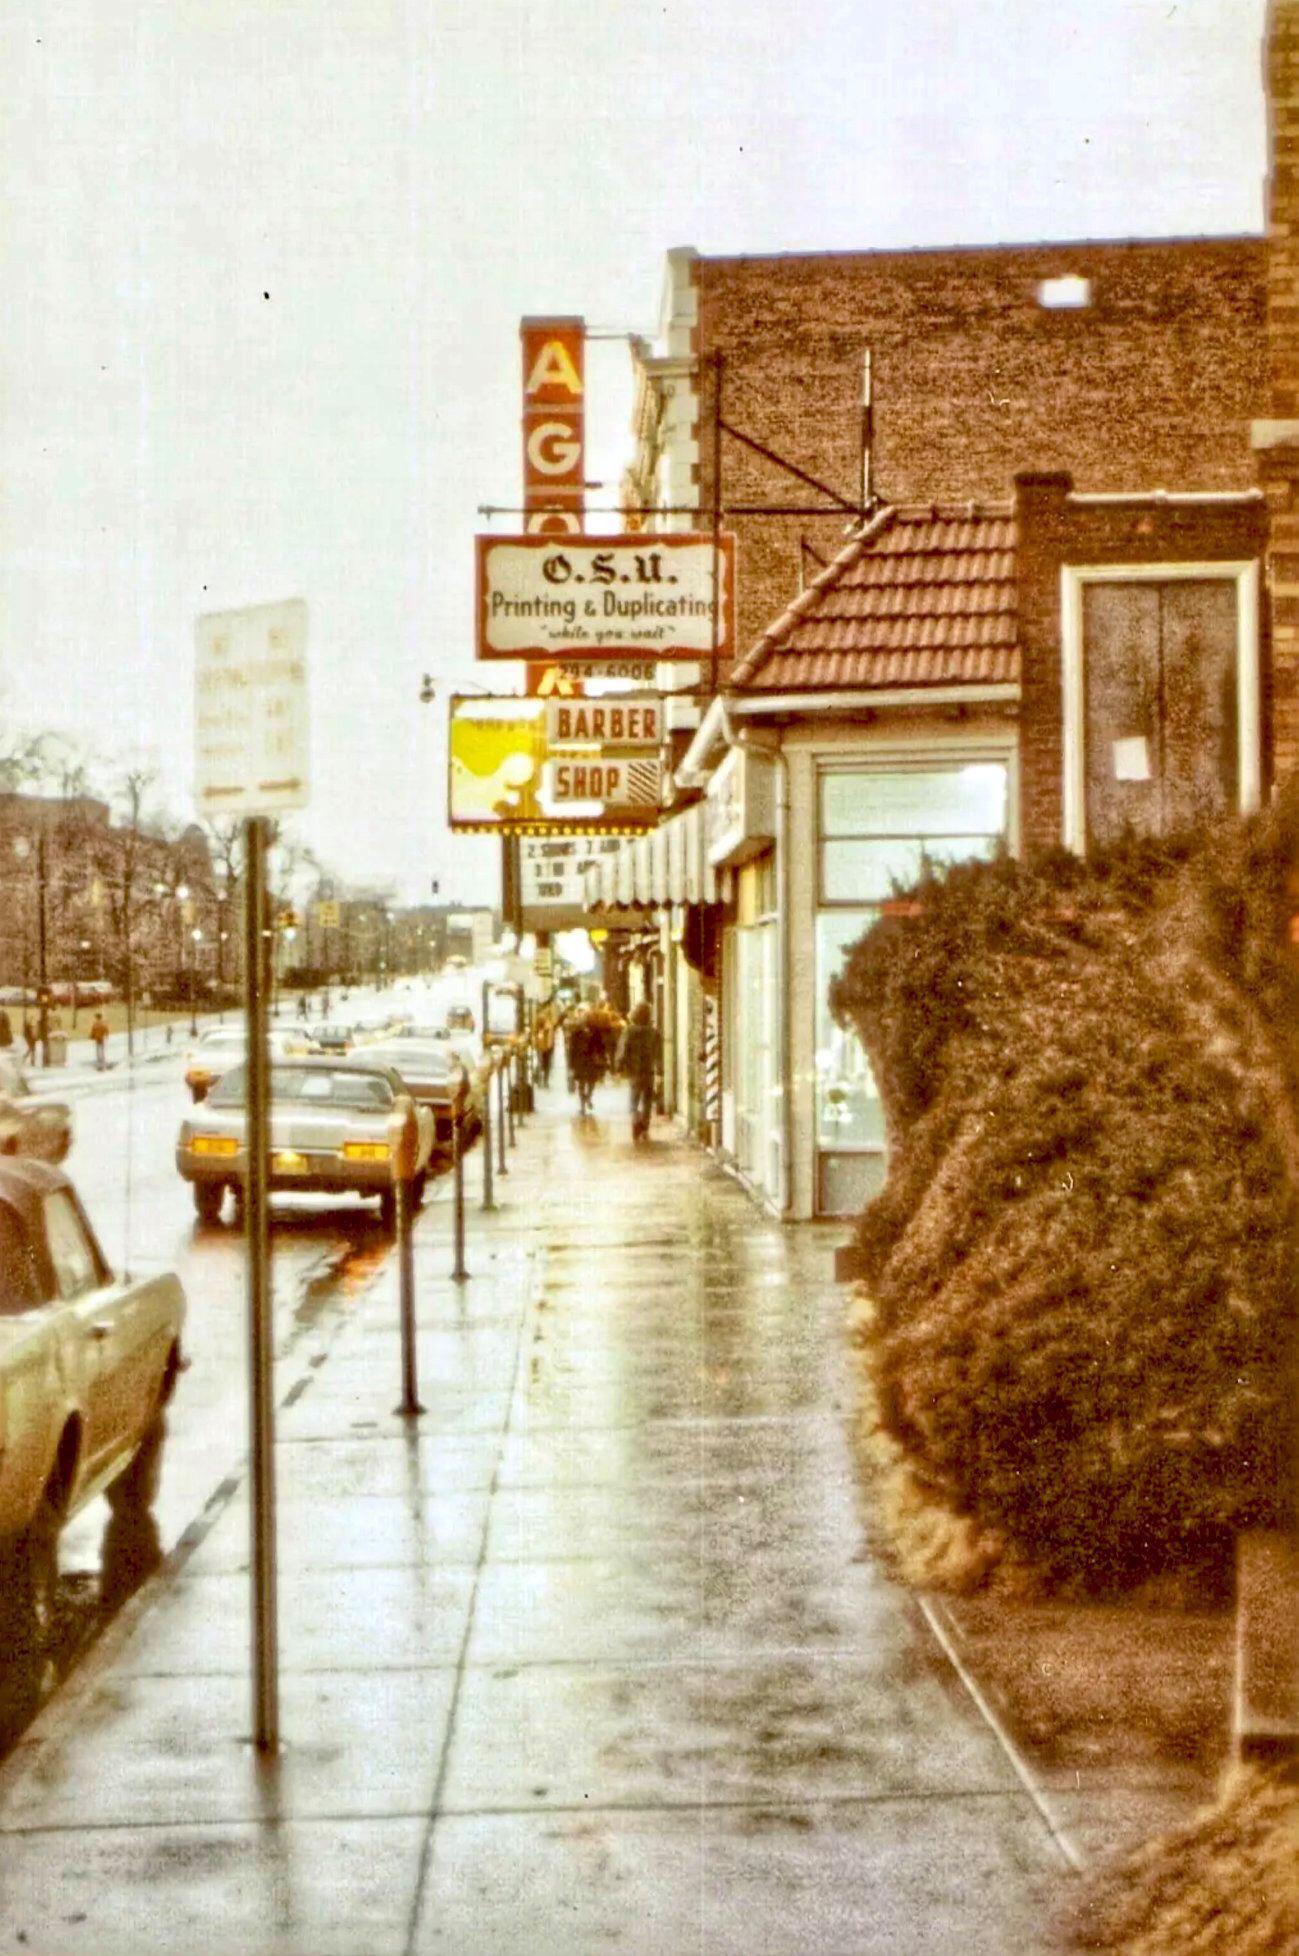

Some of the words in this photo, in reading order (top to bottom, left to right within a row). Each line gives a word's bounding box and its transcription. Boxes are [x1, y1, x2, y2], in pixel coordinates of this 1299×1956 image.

[542, 553, 679, 584] O.S.U.
[491, 590, 576, 623] Printing
[584, 601, 597, 617] &
[557, 707, 657, 739] BARBER
[557, 765, 620, 799] SHOP
